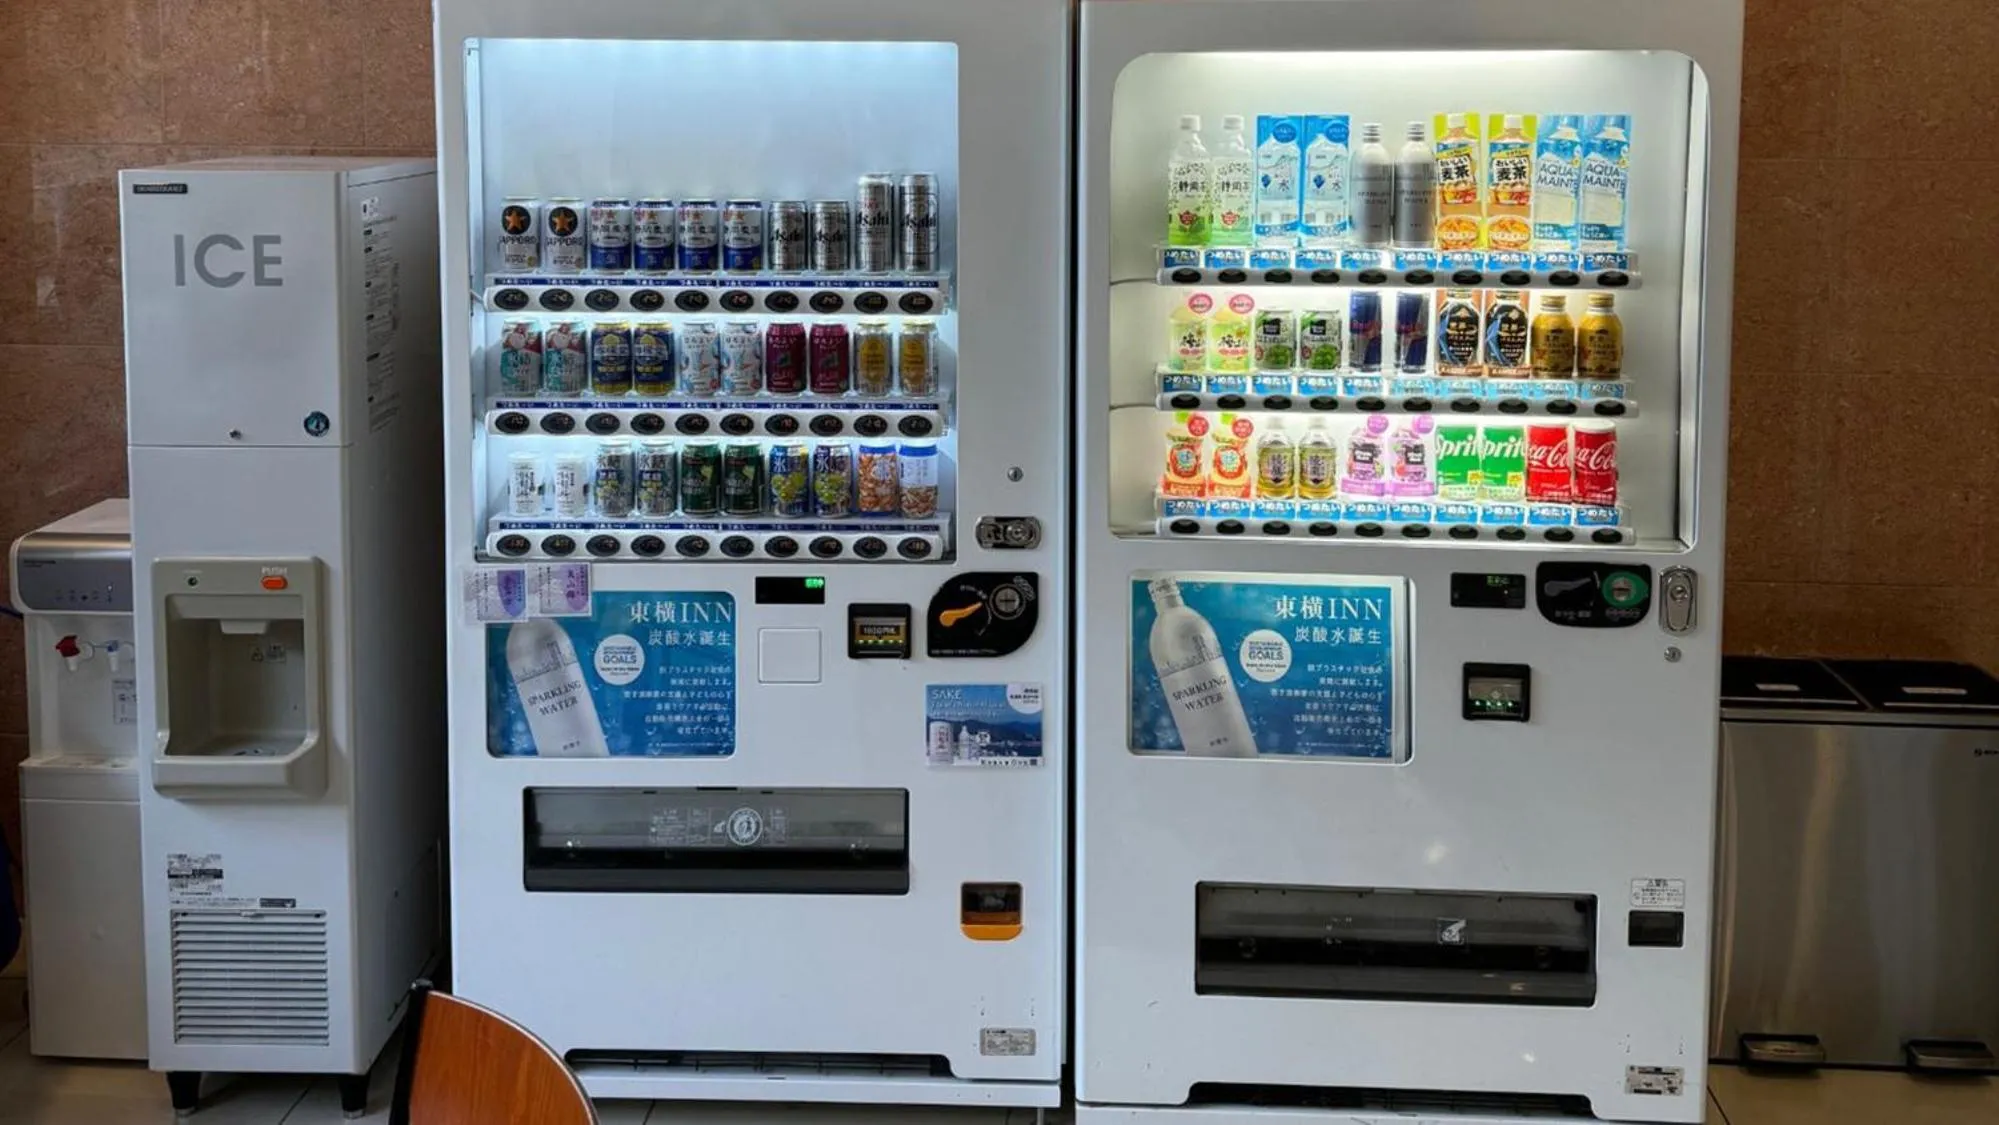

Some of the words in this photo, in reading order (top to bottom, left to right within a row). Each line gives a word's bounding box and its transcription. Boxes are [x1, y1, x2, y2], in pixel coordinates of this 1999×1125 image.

[1441, 165, 1469, 180] 麦茶
[1497, 166, 1527, 180] 麦茶
[1540, 164, 1573, 176] AQUA
[1586, 164, 1620, 176] AQUA
[856, 211, 890, 227] Asahi
[900, 213, 936, 229] Asahi
[498, 235, 537, 245] SAPPORO
[545, 236, 584, 247] SAPPORO
[174, 233, 284, 288] ICE
[1167, 502, 1205, 510] つめたい
[1212, 502, 1250, 511] つめたい
[1256, 502, 1295, 511] つめたい
[1301, 503, 1340, 512] つめたい
[1347, 504, 1387, 513] つめたい
[1391, 505, 1431, 514] つめたい
[1439, 505, 1478, 514] つめたい
[1486, 506, 1525, 515] つめたい
[1531, 506, 1571, 516] つめたい
[1578, 507, 1617, 517] つめたい
[628, 601, 733, 624] 東横INN
[1274, 595, 1383, 621] 東横INN
[648, 630, 731, 646] 炭酸水誕生
[1295, 626, 1382, 645] 炭酸水誕生
[602, 654, 638, 665] GOALS
[1248, 650, 1284, 661] GOALS
[527, 680, 582, 707] SPARKLING
[932, 687, 962, 701] SAKE
[1172, 674, 1228, 703] SPARKLING
[538, 696, 579, 717] WATER
[1184, 692, 1224, 713] WATER
